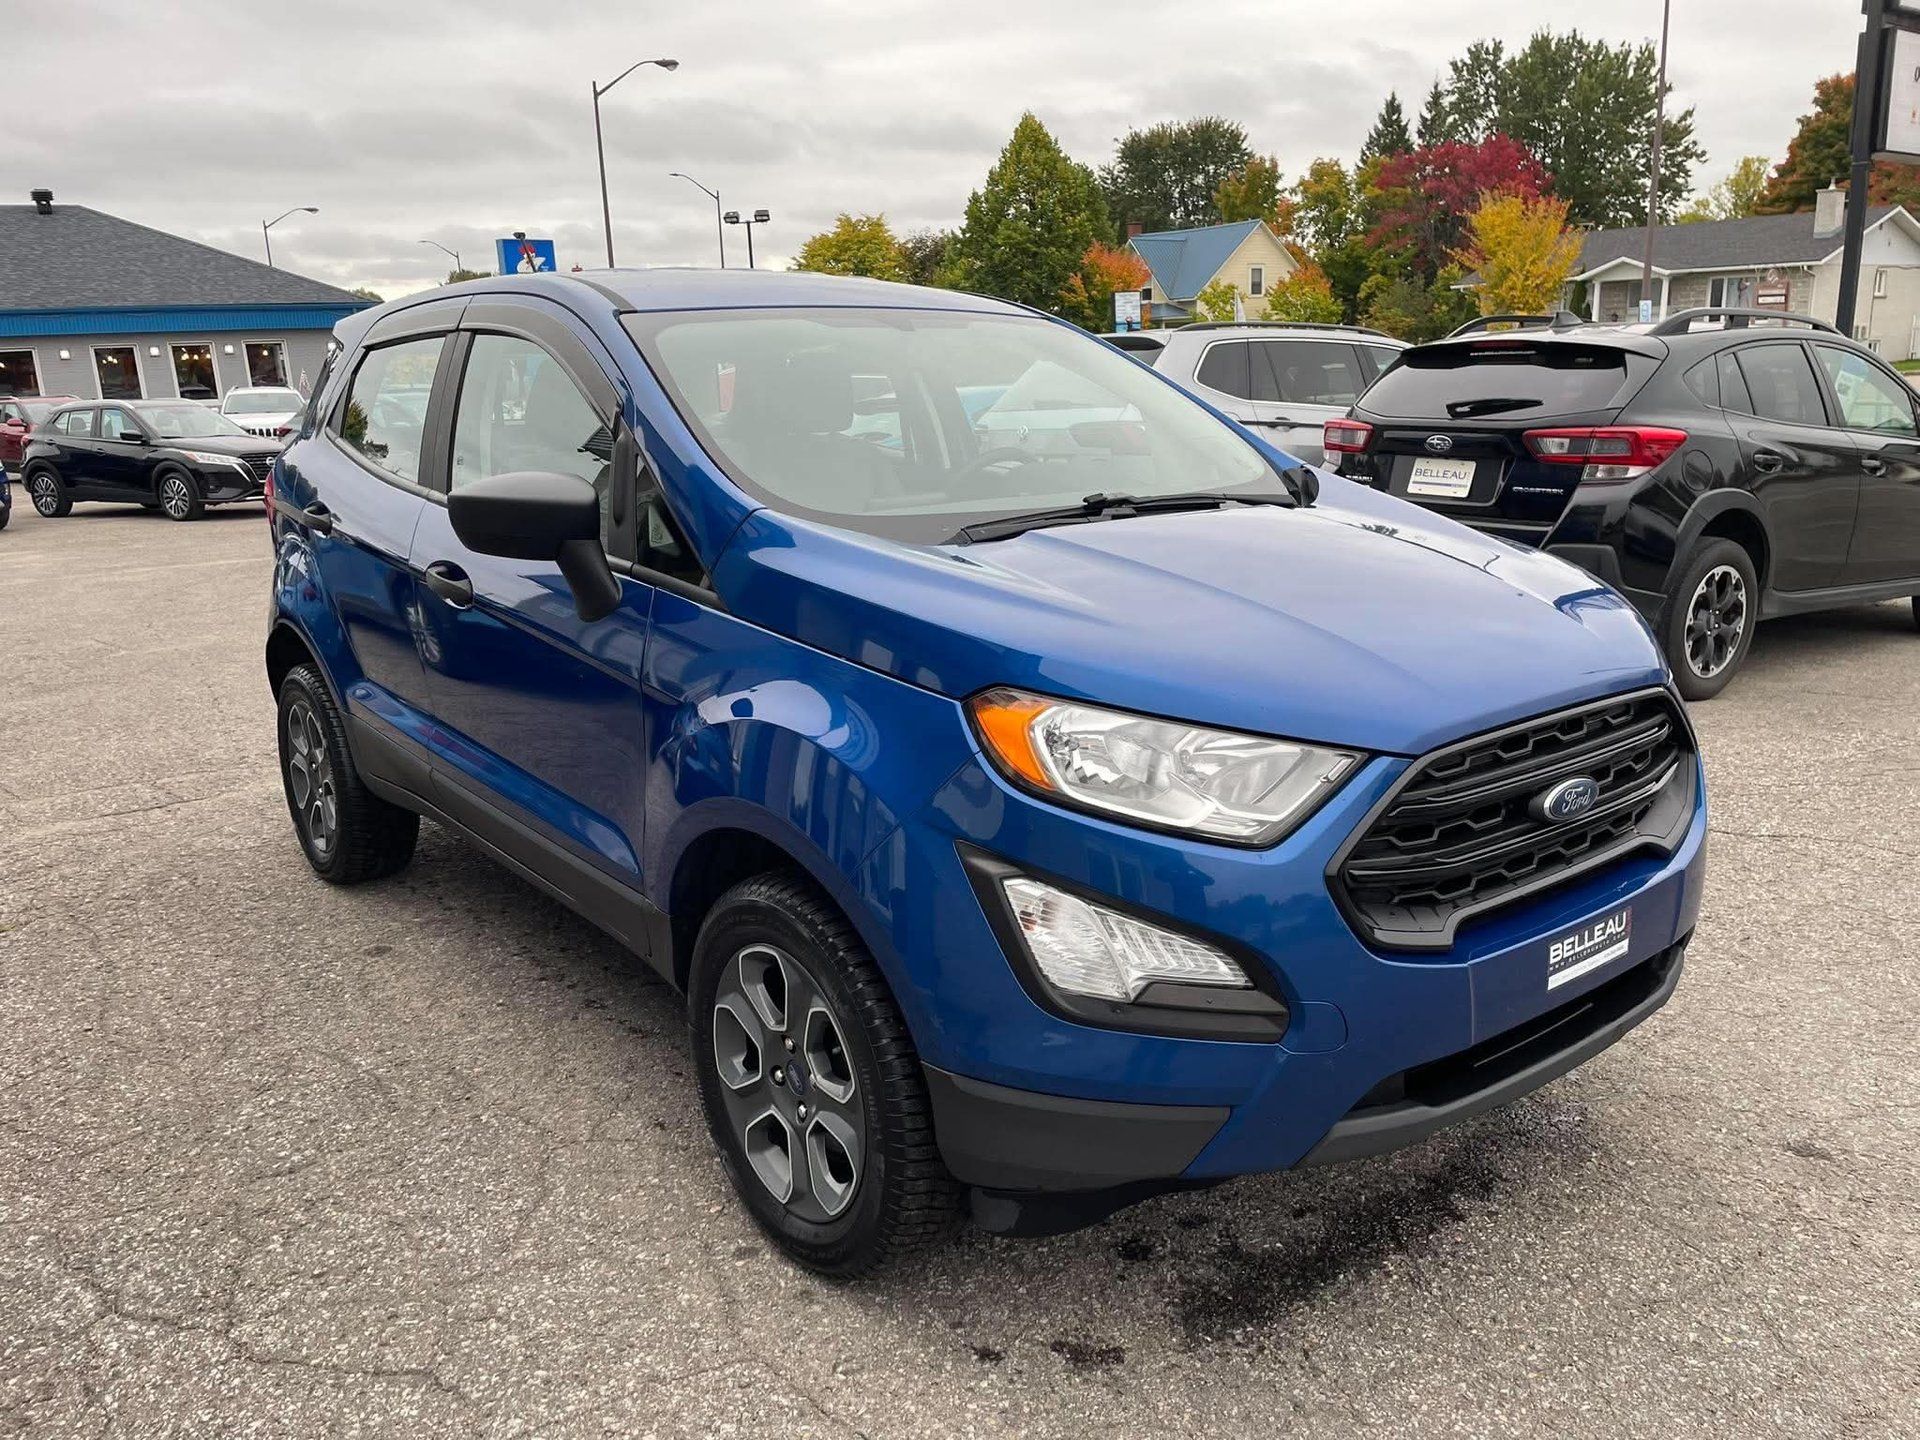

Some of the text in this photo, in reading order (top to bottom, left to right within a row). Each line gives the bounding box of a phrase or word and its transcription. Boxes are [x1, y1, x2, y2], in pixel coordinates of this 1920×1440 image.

[1415, 468, 1467, 480] BELLEAU
[1562, 786, 1591, 813] Ford
[1549, 911, 1627, 965] BELLEAU
